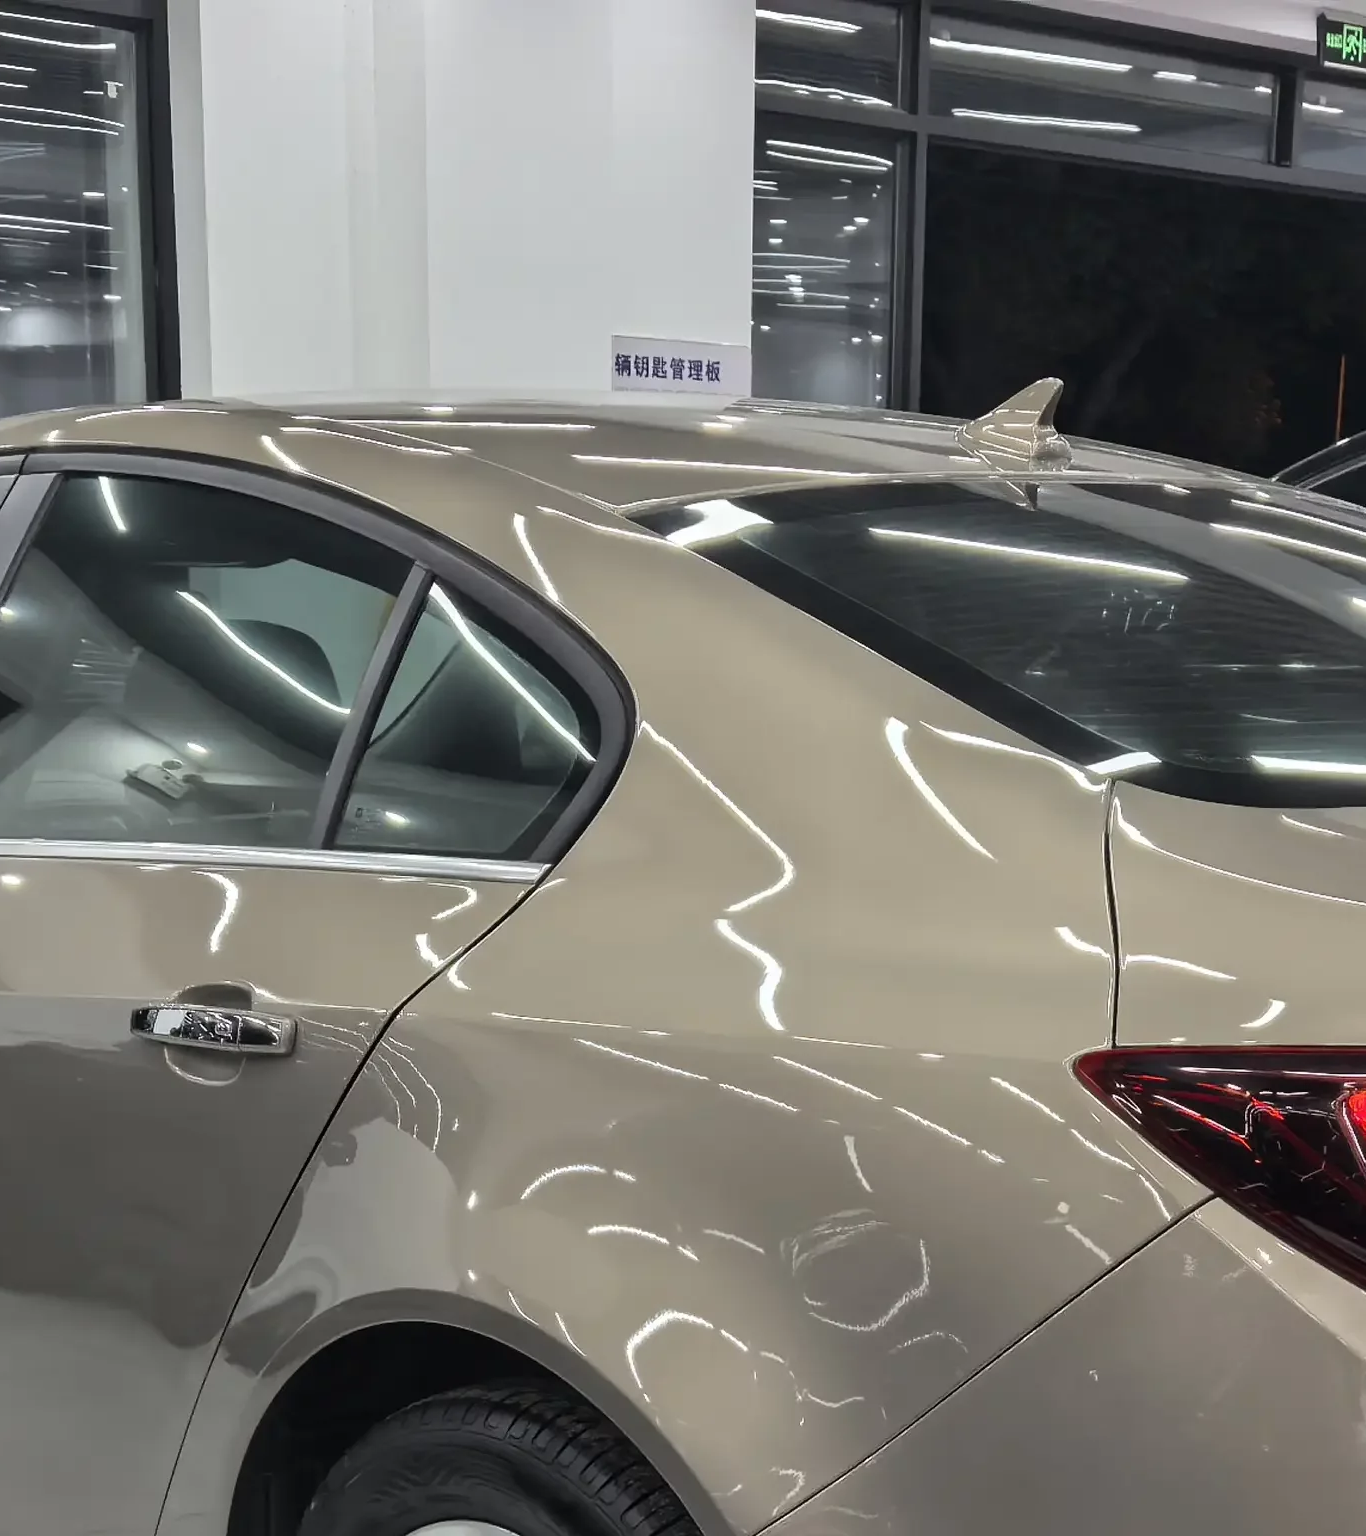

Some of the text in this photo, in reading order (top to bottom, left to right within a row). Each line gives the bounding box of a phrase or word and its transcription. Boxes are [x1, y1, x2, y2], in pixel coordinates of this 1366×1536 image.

[614, 353, 721, 382] 辆钥匙管理板
